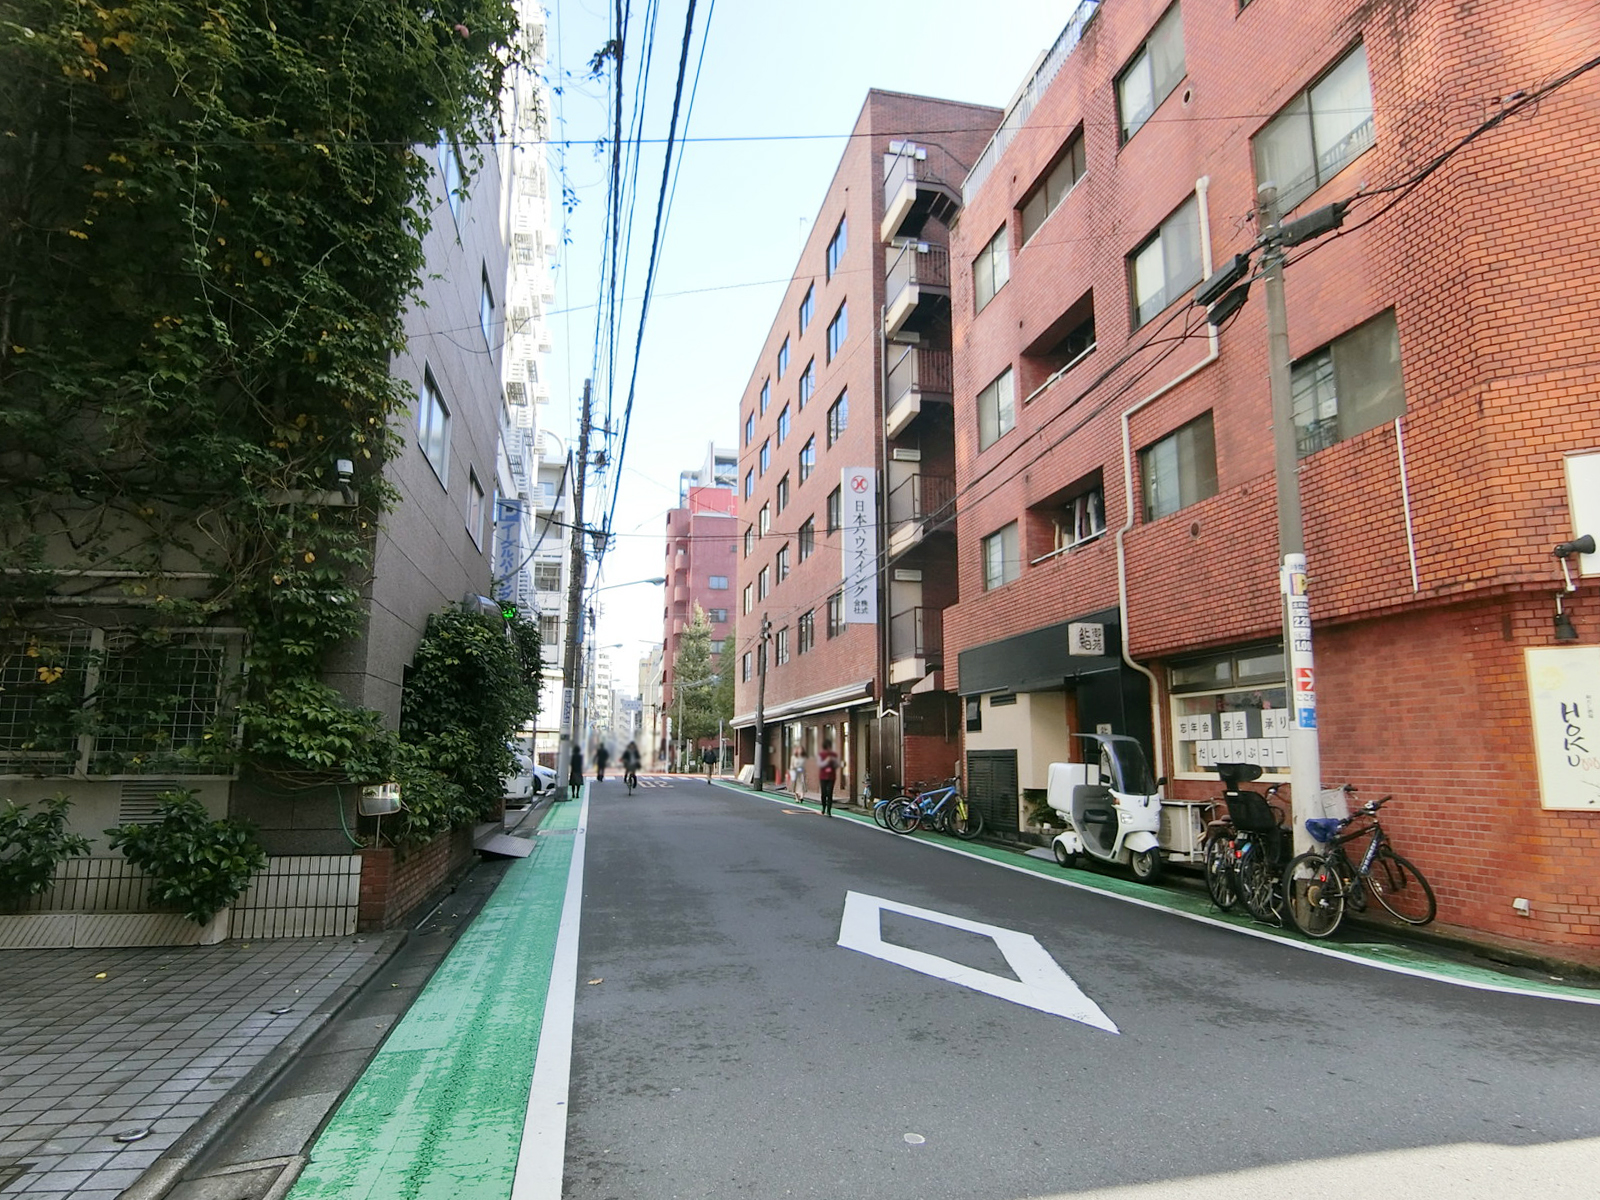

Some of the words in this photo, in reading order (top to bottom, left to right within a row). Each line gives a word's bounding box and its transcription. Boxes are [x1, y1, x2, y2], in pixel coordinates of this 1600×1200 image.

[501, 504, 518, 519] P
[853, 500, 868, 598] 日本ハウズイング
[1179, 721, 1209, 734] 忘年会
[1222, 720, 1244, 732] 宴会
[1264, 717, 1288, 730] 承り
[1198, 748, 1284, 760] だししゃぶコー
